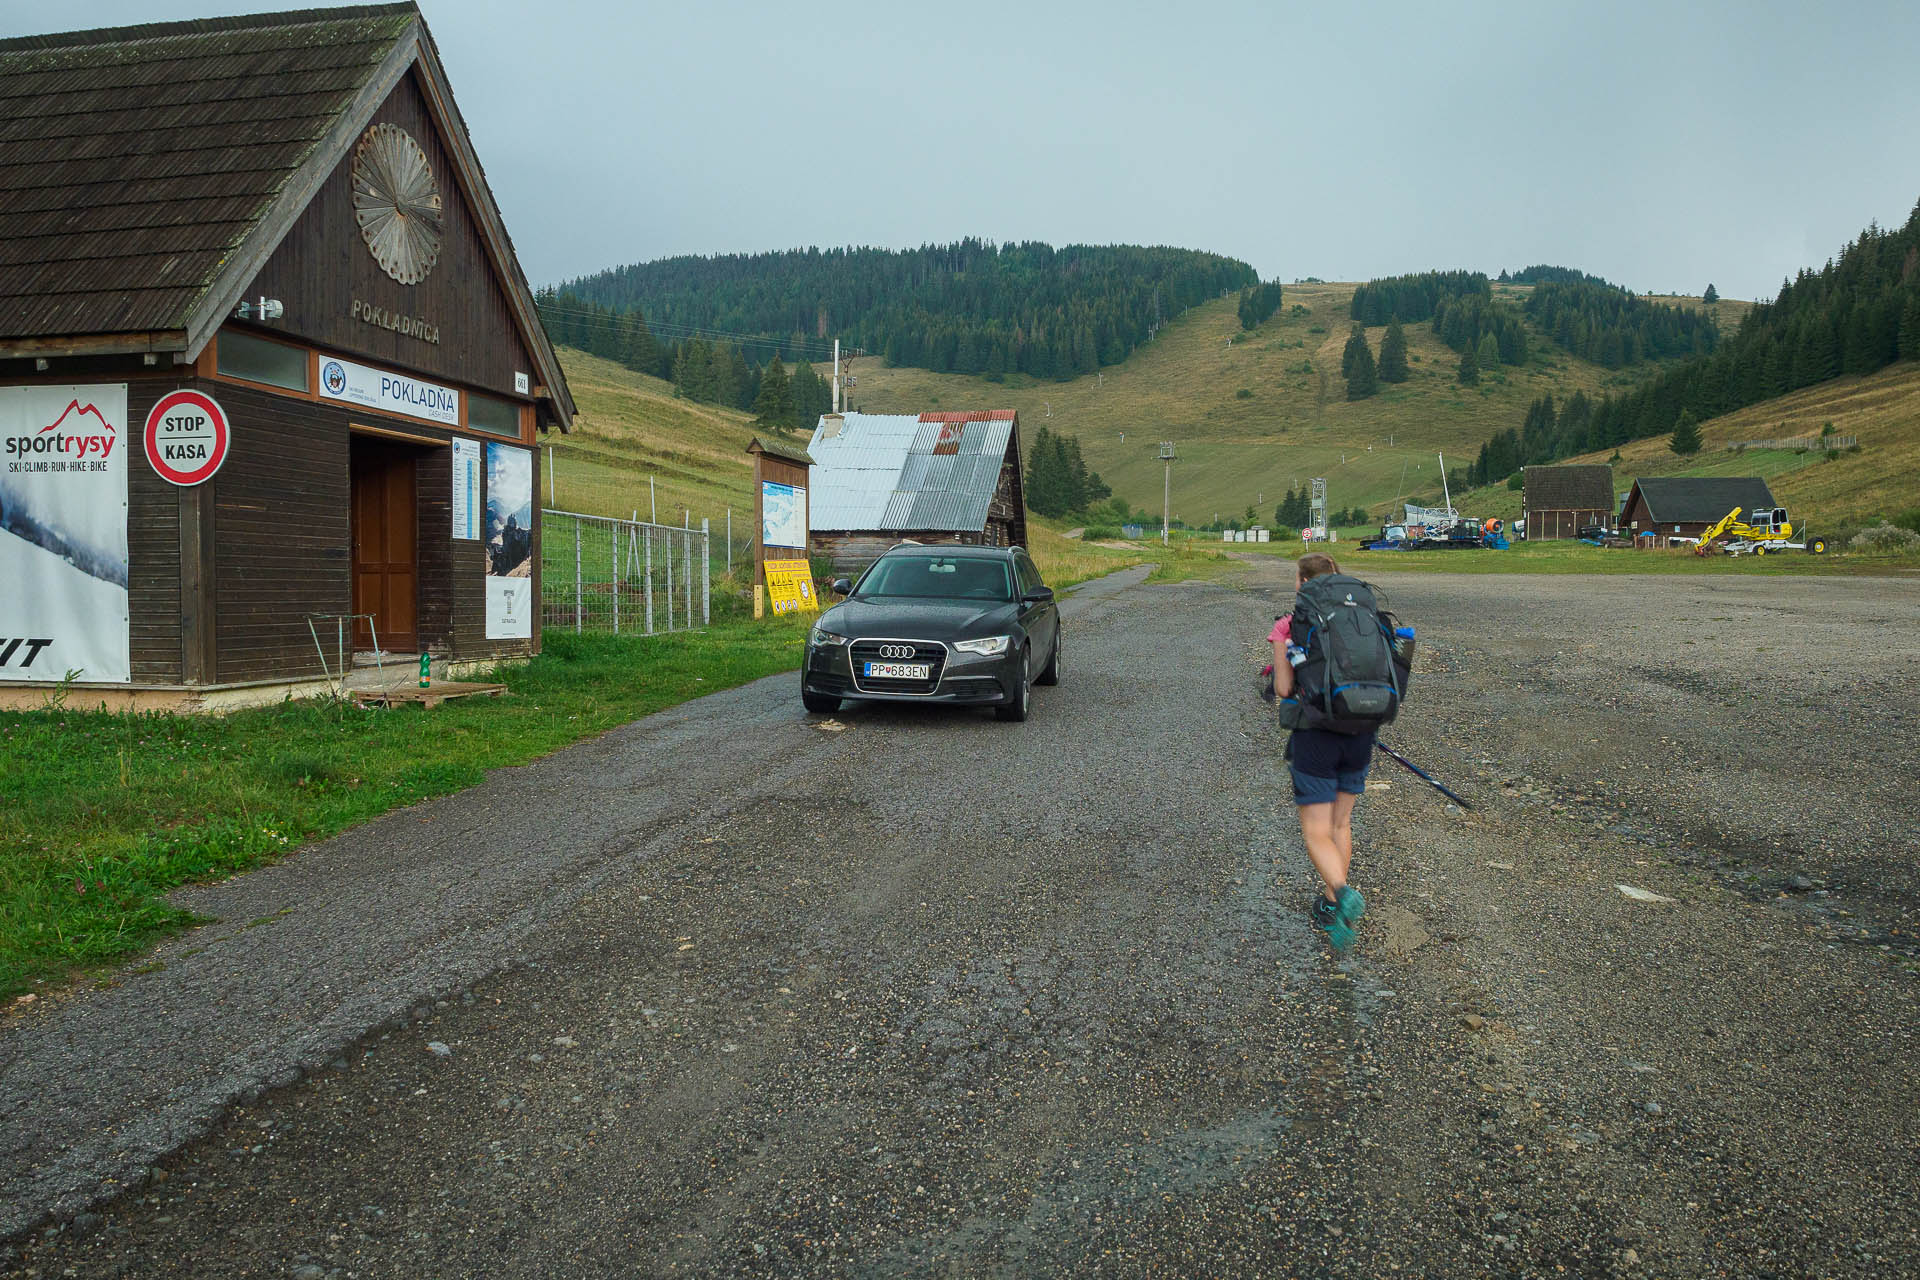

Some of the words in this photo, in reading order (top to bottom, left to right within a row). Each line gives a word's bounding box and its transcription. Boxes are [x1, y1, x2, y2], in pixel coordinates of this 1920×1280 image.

[382, 377, 455, 413] POKLADŇA
[165, 416, 205, 432] STOP
[6, 432, 115, 460] sportrysy
[165, 444, 207, 460] KASA
